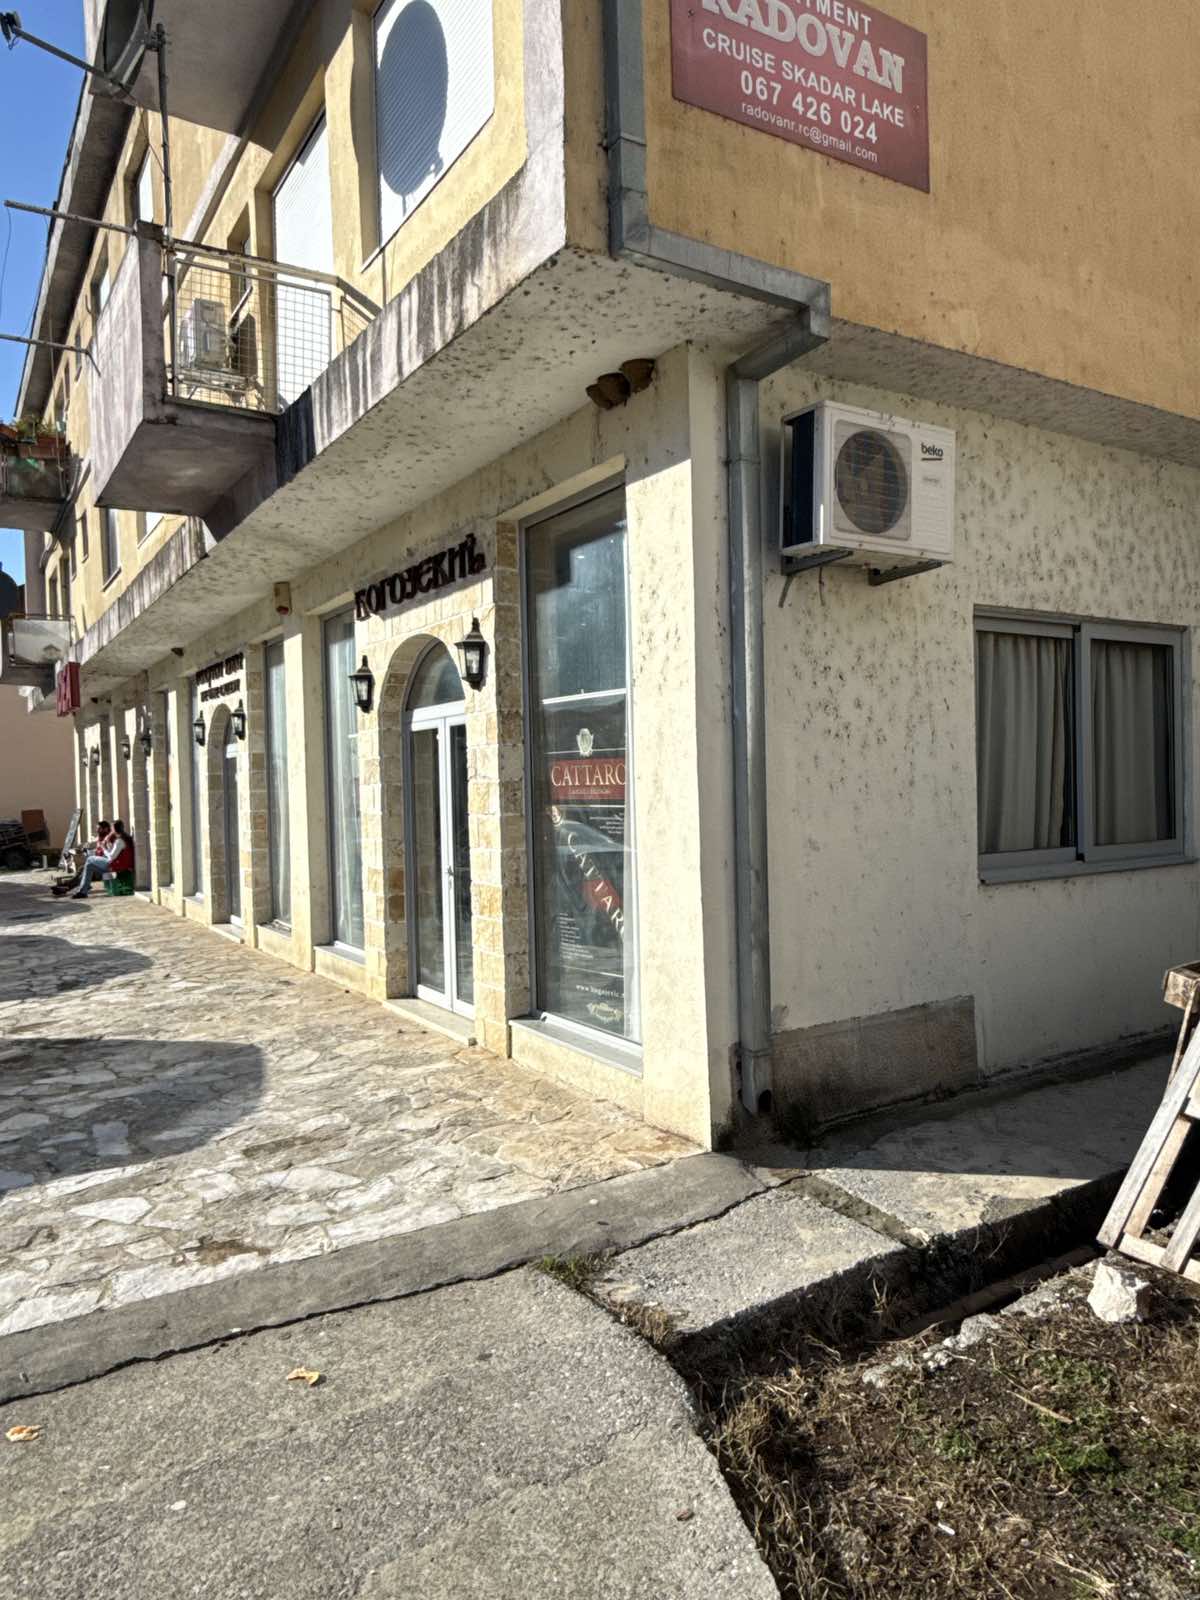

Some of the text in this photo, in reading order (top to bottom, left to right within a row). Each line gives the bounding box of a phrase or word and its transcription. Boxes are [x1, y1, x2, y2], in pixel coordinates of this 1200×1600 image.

[702, 28, 905, 127] CRUISE SKADAR LAKE
[740, 70, 878, 144] 067 426 024
[741, 102, 878, 162] radovanr.rc@gmail.com
[920, 442, 944, 457] beko
